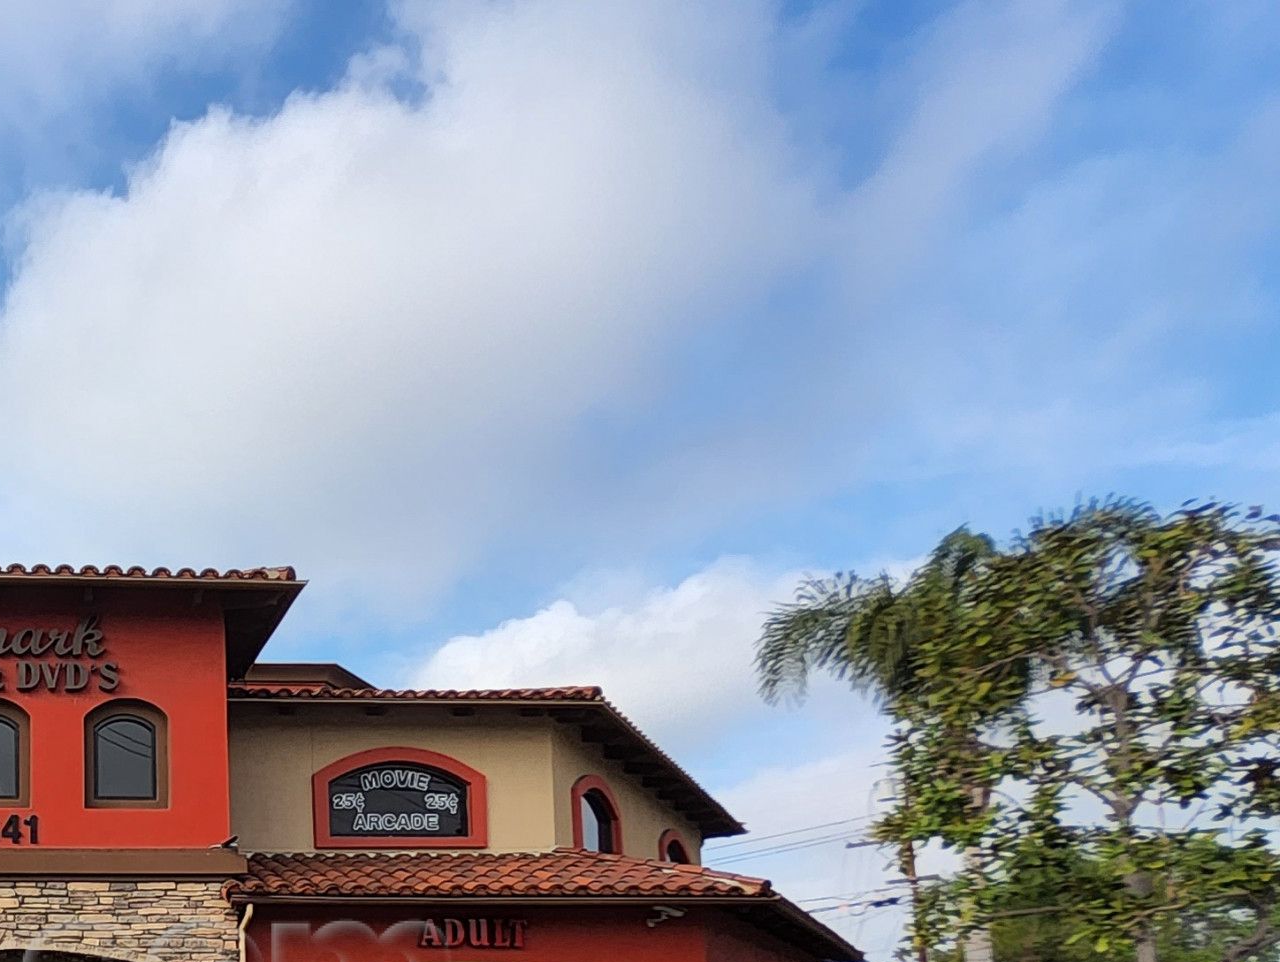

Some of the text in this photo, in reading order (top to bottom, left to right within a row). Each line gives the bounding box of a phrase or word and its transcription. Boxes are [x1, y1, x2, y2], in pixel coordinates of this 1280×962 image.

[16, 661, 121, 692] DVD'S
[361, 770, 431, 791] MOVIE
[333, 793, 459, 814] 25¢ 25¢
[353, 813, 440, 831] ARCADE
[421, 918, 528, 947] ADULT
